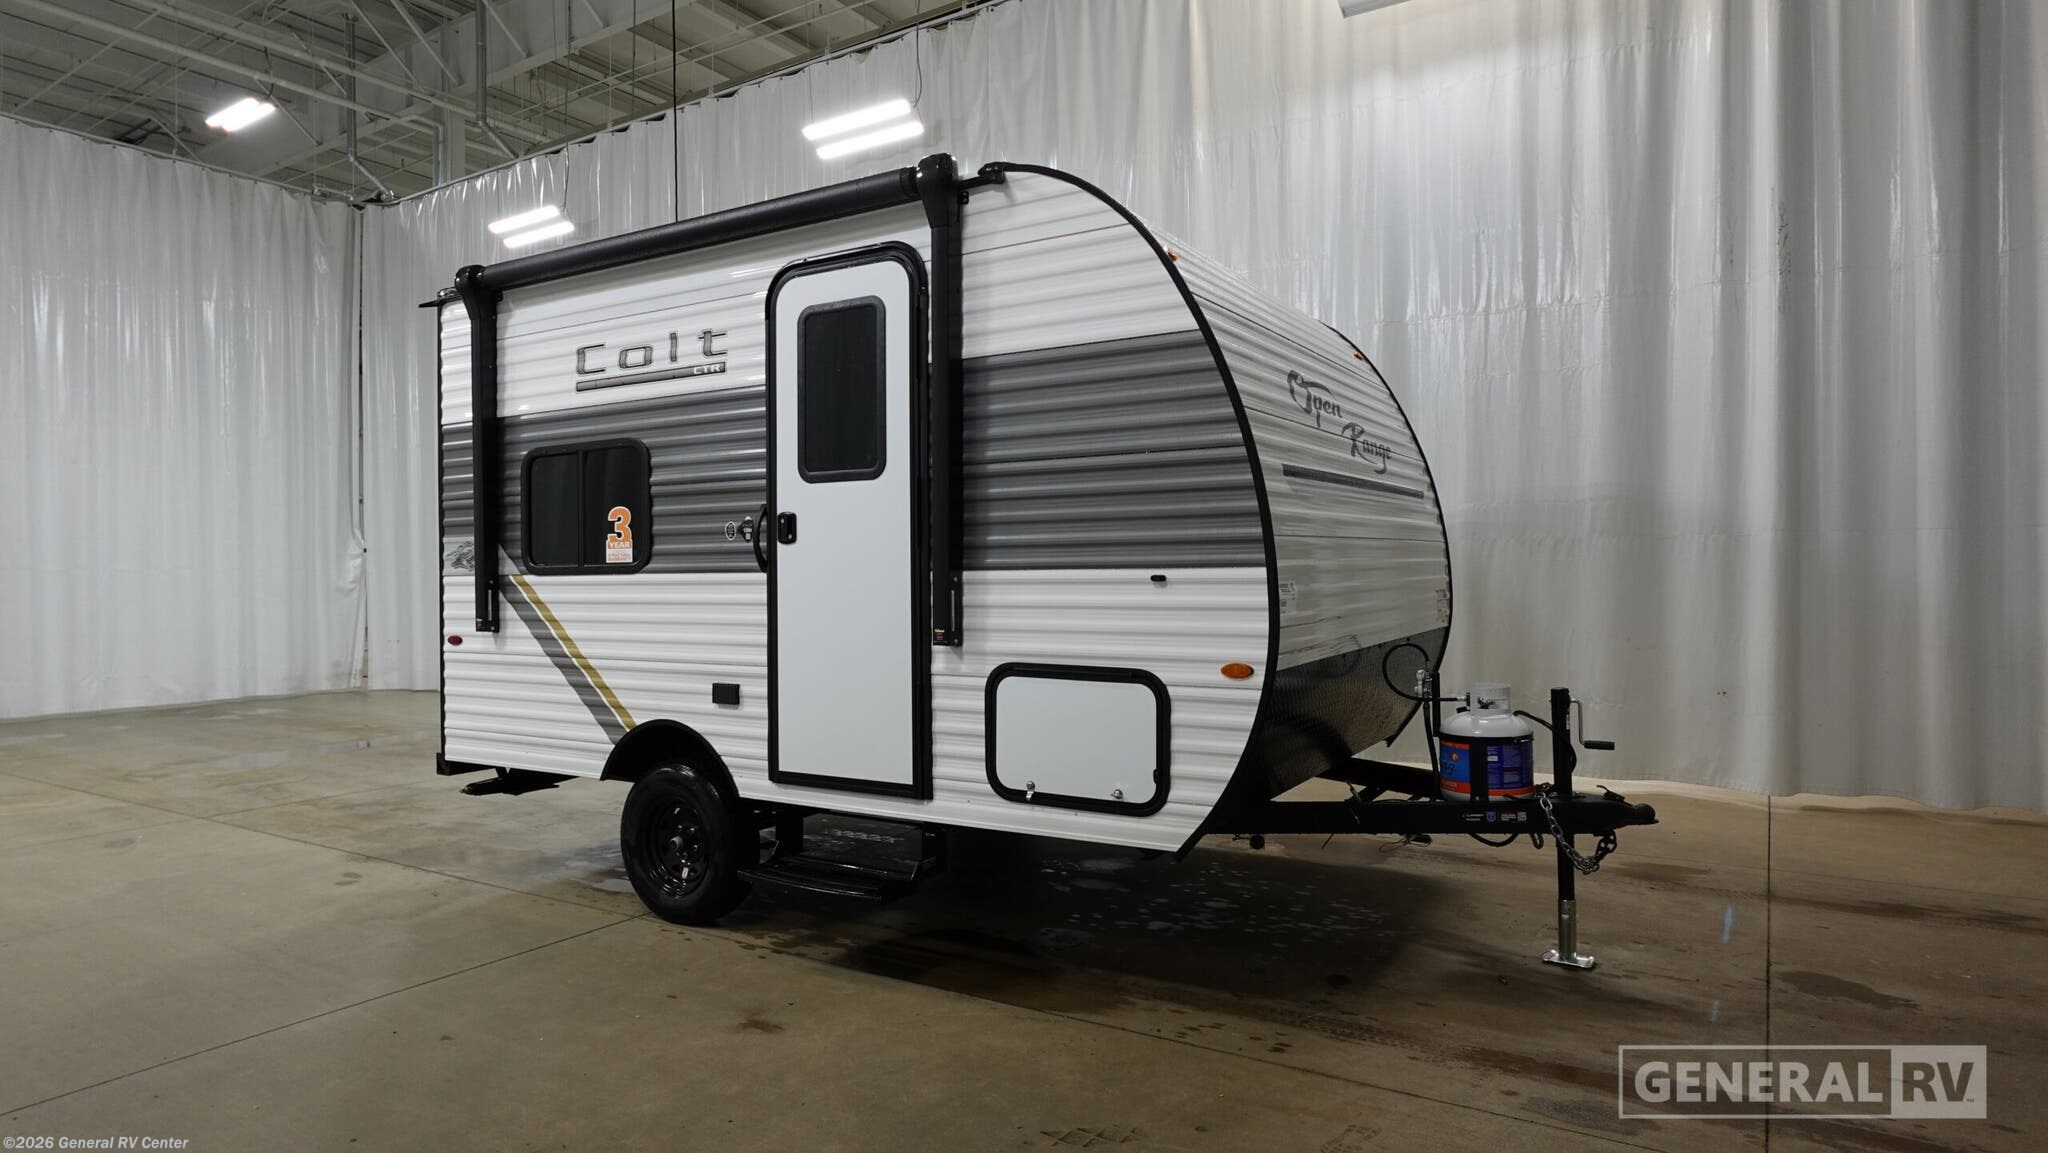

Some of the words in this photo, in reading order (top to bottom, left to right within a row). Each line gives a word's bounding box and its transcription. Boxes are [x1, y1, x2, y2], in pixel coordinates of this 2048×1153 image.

[576, 330, 727, 375] Colt
[692, 363, 722, 376] CTR
[1286, 369, 1343, 428] Open
[1341, 421, 1393, 475] Range
[607, 506, 632, 543] 3
[609, 541, 631, 549] YEAR
